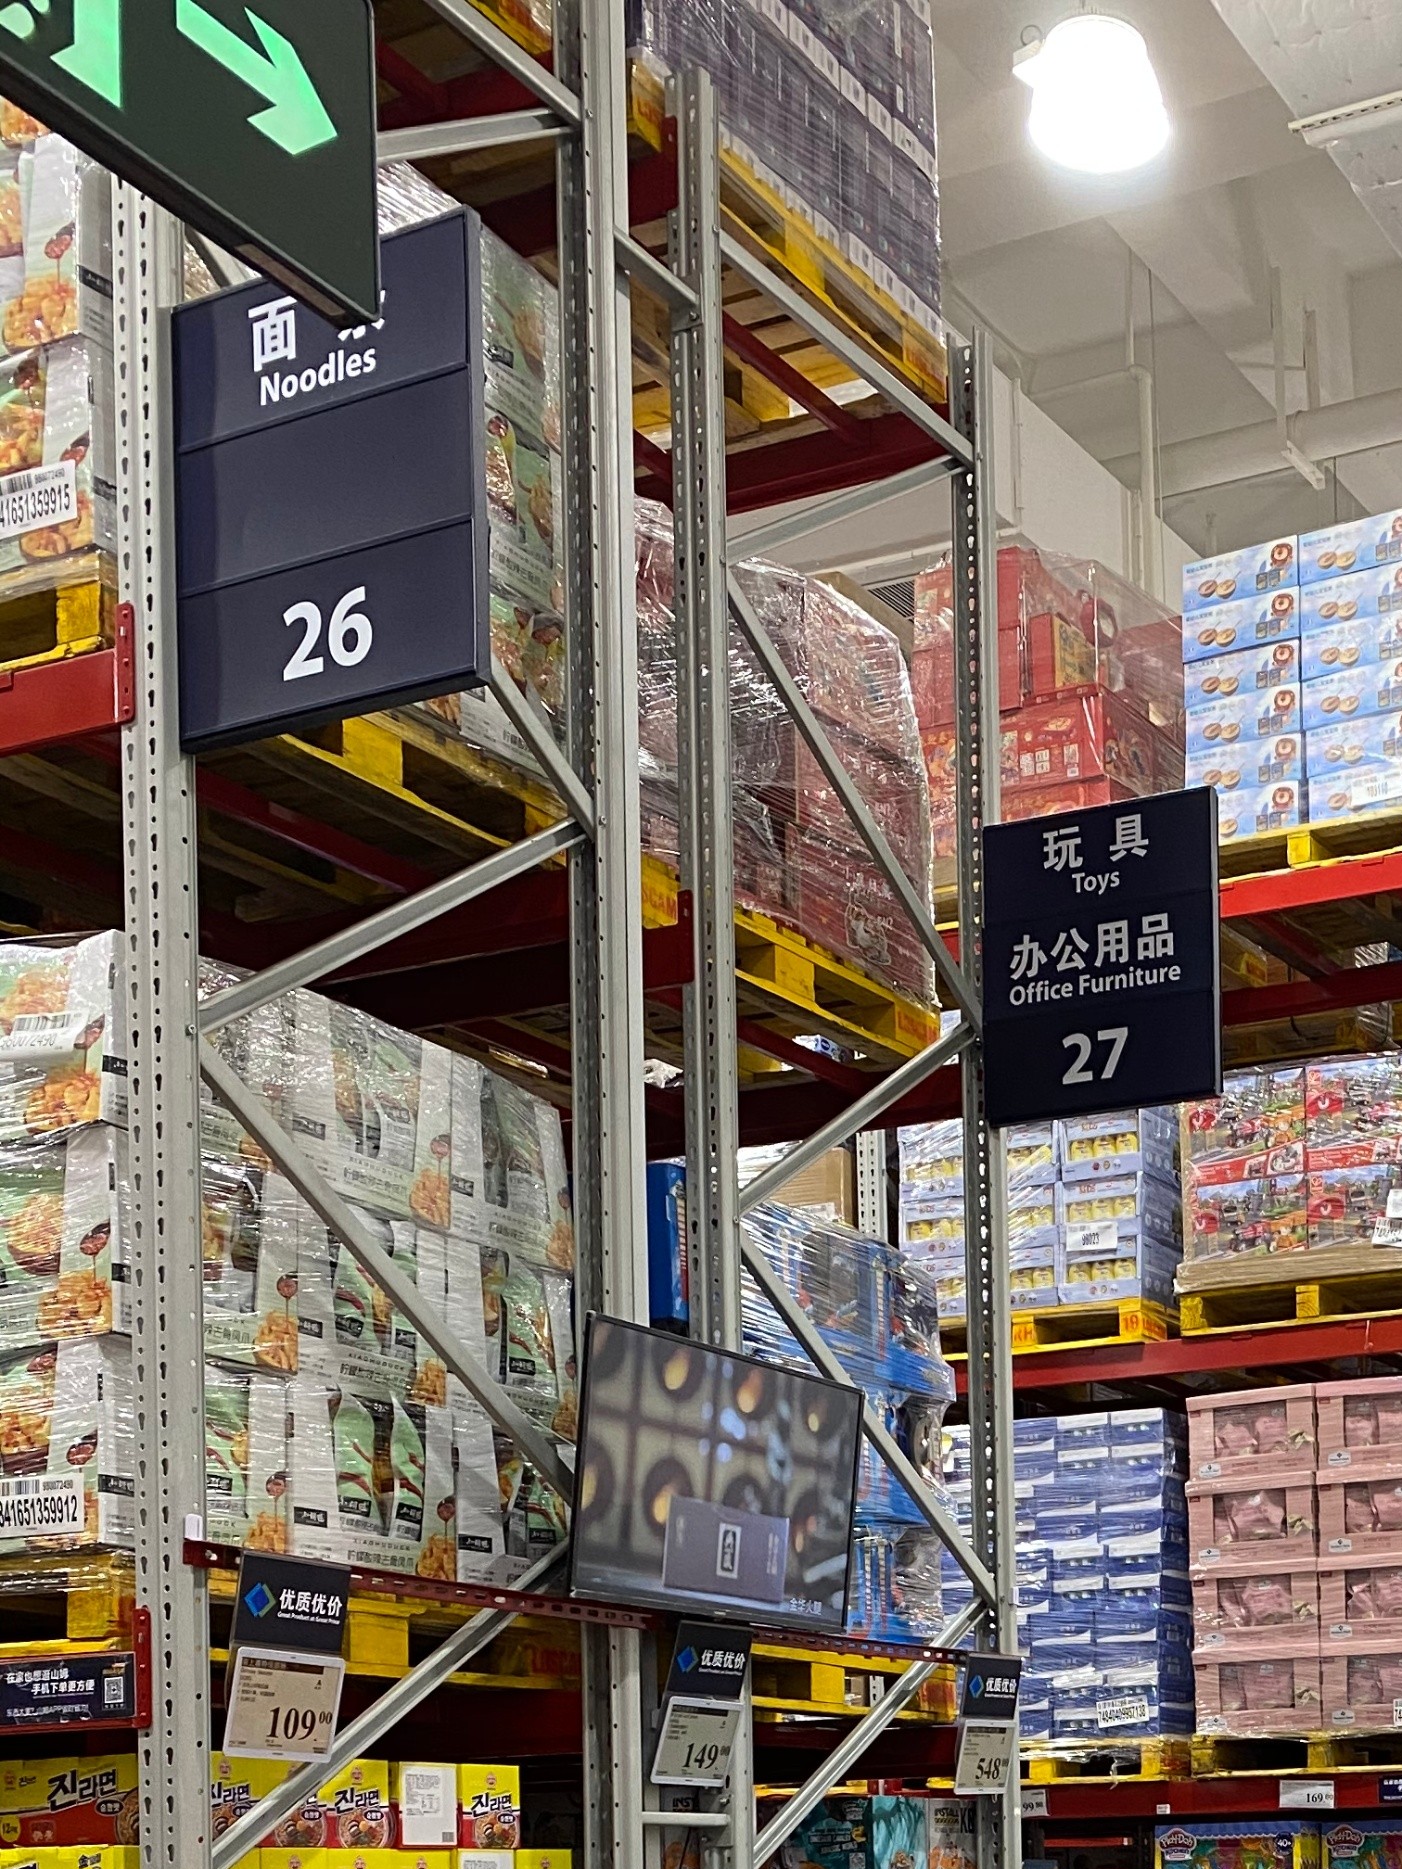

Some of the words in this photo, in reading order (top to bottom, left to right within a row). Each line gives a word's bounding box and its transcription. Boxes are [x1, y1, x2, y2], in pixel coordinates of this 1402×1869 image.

[258, 345, 377, 406] Noodles
[282, 586, 374, 681] 26
[1042, 814, 1150, 873] 玩具
[1071, 868, 1120, 895] Toys
[1009, 911, 1176, 980] 办公用品
[1009, 977, 1075, 1007] Office
[1079, 961, 1181, 998] Furniture
[1061, 1027, 1130, 1085] 27
[279, 1588, 343, 1617] 优质优价
[701, 1648, 746, 1670] 优质优价
[31, 1680, 95, 1695] 手机下单更方便
[986, 1677, 1017, 1697] 优质优价
[47, 1769, 118, 1812] 진라면
[335, 1789, 379, 1814] 진라면
[471, 1793, 512, 1816] 진라면
[1276, 1837, 1292, 1848] 40+
